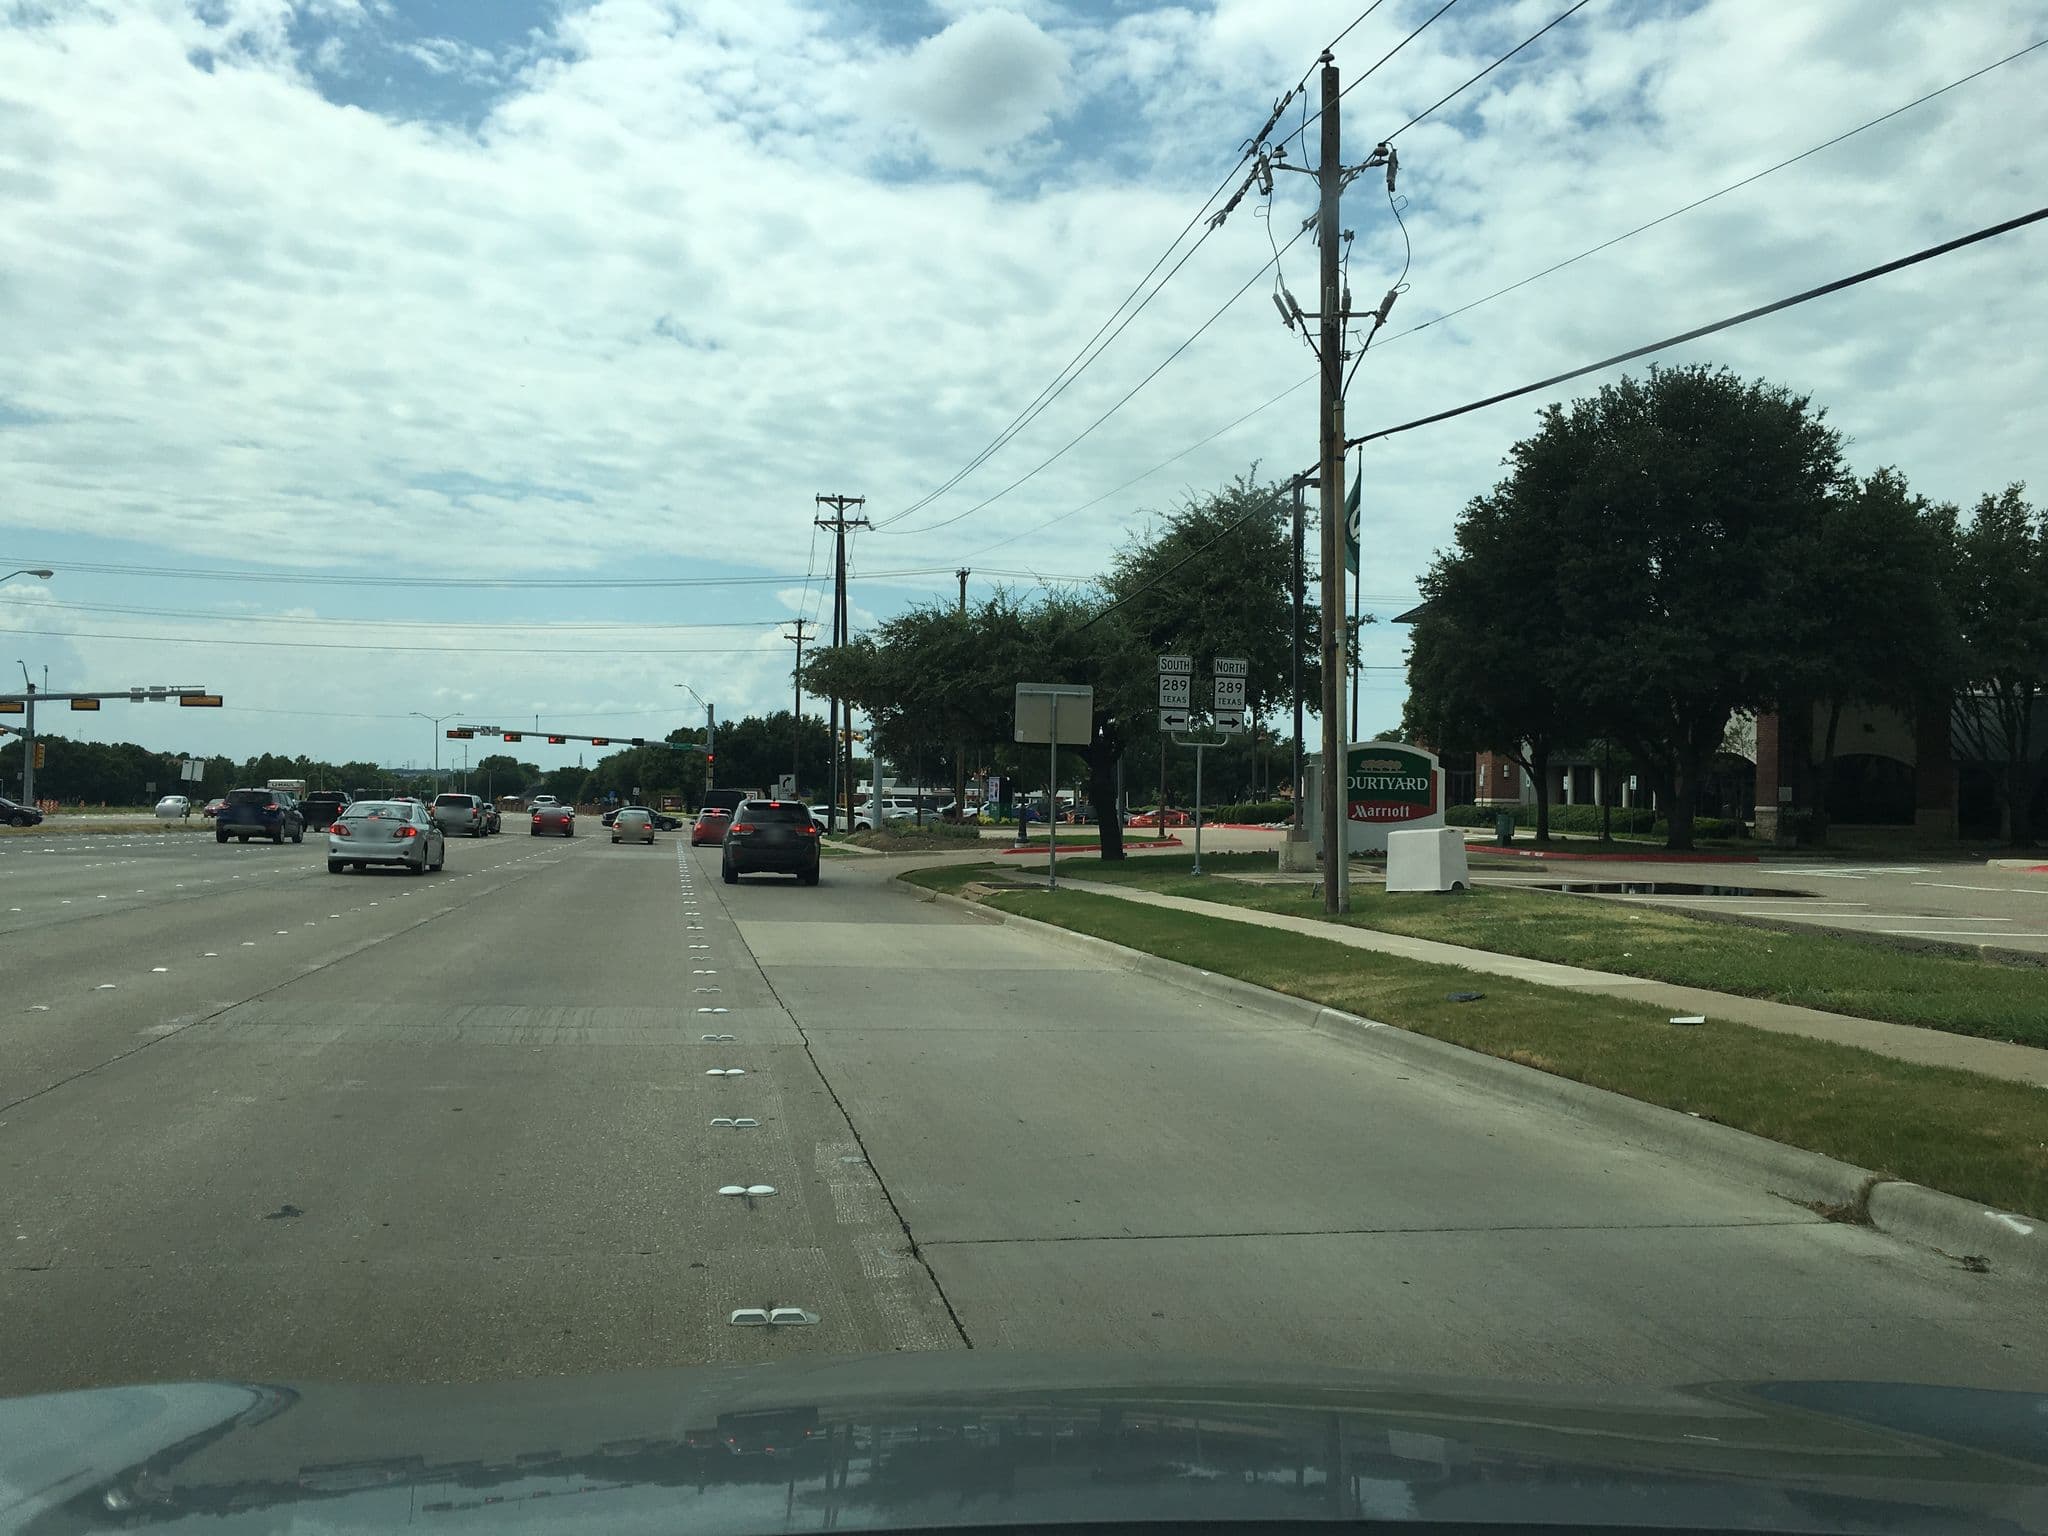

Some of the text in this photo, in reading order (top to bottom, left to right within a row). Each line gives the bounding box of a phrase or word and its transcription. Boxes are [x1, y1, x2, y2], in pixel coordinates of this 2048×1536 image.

[1161, 658, 1190, 670] SOUTH
[1216, 660, 1245, 673] NORTH
[1162, 680, 1187, 691] 289
[1218, 682, 1242, 693] 289
[1347, 776, 1428, 790] OURTYARD
[1352, 805, 1409, 818] Marriott
